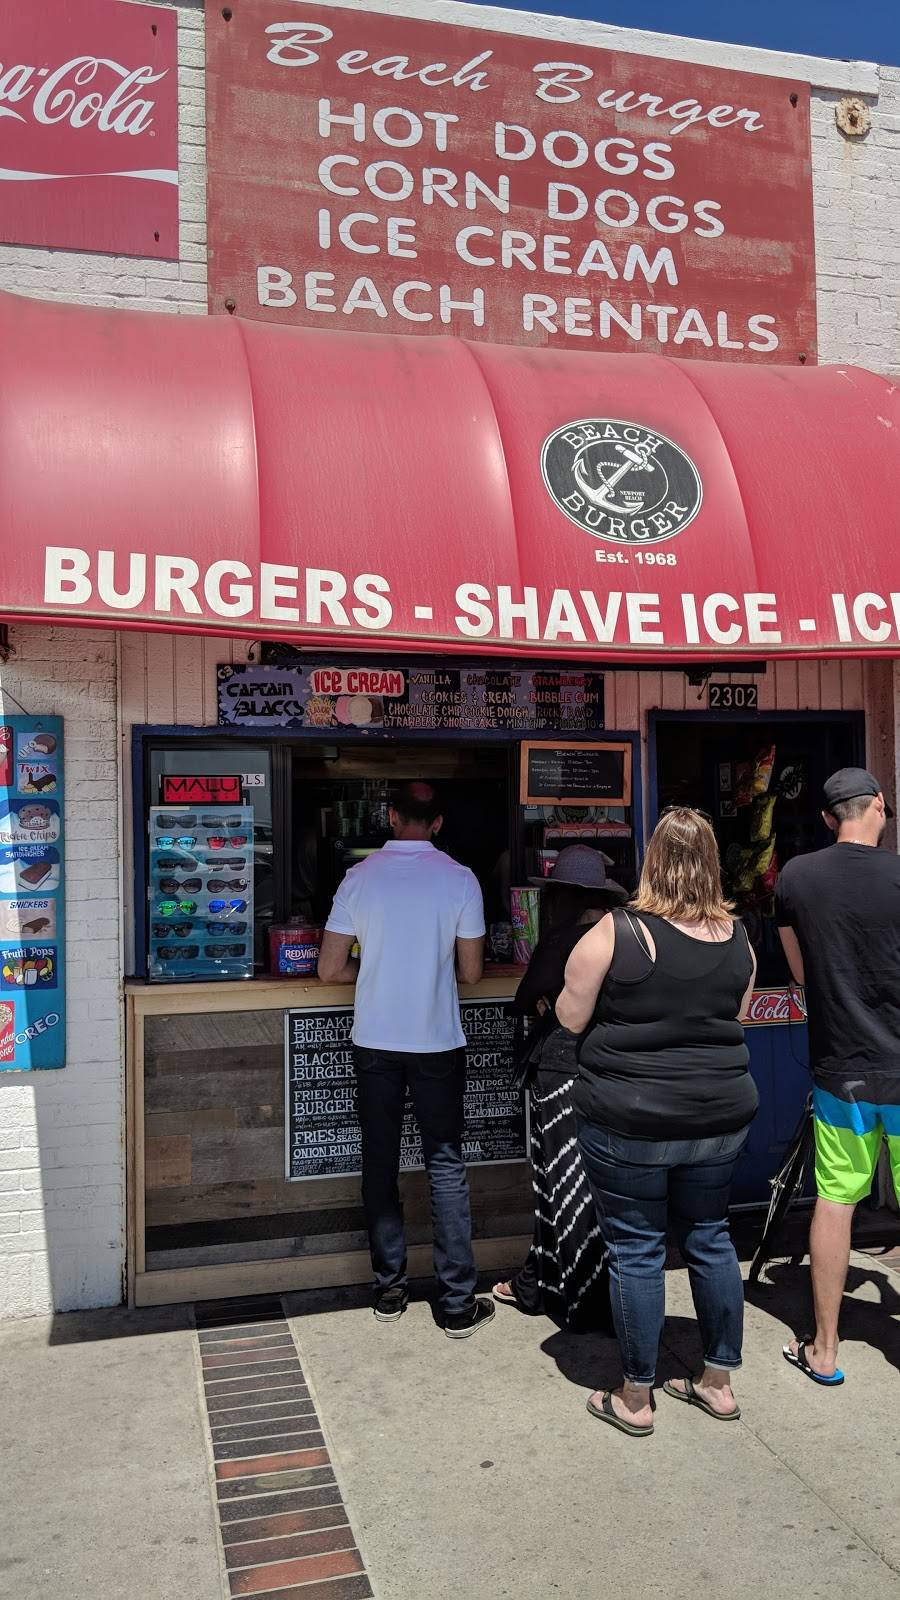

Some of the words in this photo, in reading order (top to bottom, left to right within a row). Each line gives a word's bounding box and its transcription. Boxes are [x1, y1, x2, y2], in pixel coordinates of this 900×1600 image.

[264, 22, 493, 92] Beach
[533, 62, 764, 135] Burger
[0, 56, 169, 136] a-Cola
[318, 98, 459, 152] HOT
[495, 121, 675, 180] DOGS
[318, 154, 510, 215] CORN
[547, 182, 724, 239] DOGS
[318, 208, 418, 259] ICE
[455, 226, 679, 286] CREAM
[257, 266, 485, 327] BEACH
[523, 293, 779, 352] RENTALS
[561, 424, 663, 454] BEACH
[562, 490, 689, 539] BURGER
[595, 550, 628, 564] Est.
[635, 551, 677, 566] 1968
[44, 546, 392, 630] BURGERS
[454, 583, 665, 644] SHAVE
[681, 592, 782, 645] ICE
[482, 692, 517, 704] CREAM
[529, 692, 572, 704] BUBBLE
[574, 692, 599, 704] GUM
[710, 686, 757, 707] 2302
[388, 703, 438, 716] CHOCOLATE
[441, 704, 462, 716] CHIP
[464, 705, 495, 717] COOKIE
[497, 706, 528, 718] DOUGH
[166, 778, 238, 793] MALU
[9, 900, 49, 909] SNICKERS
[30, 946, 54, 958] Pops
[285, 950, 302, 960] RED
[15, 1013, 60, 1045] OREO
[293, 1065, 355, 1081] BURGER
[294, 1090, 331, 1101] FRIED
[497, 1092, 520, 1101] MAID
[294, 1100, 355, 1116] BURGER
[464, 1107, 513, 1119] LEMONADE
[294, 1129, 336, 1145] FRIES
[293, 1145, 327, 1159] ONION
